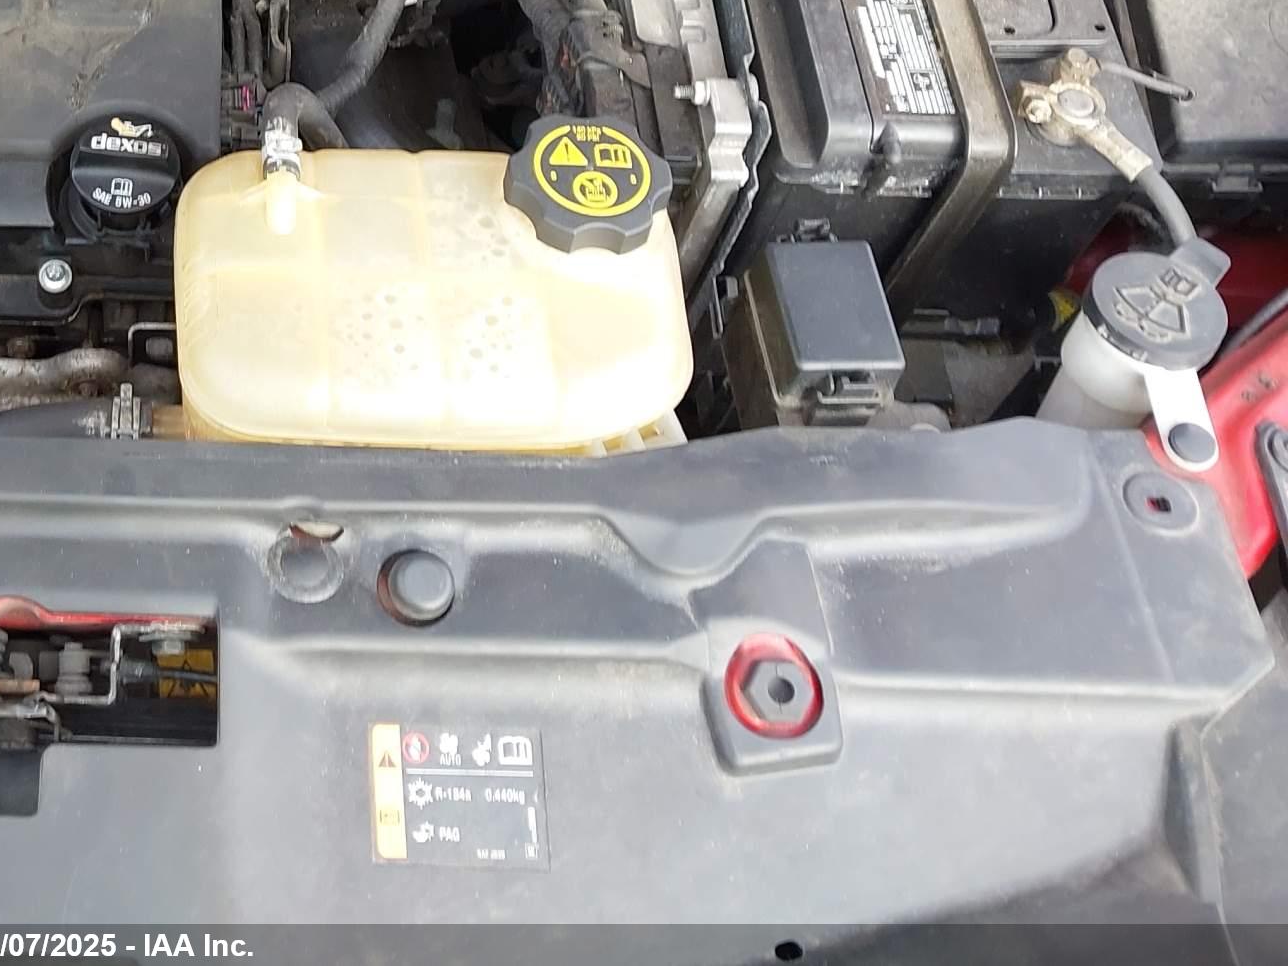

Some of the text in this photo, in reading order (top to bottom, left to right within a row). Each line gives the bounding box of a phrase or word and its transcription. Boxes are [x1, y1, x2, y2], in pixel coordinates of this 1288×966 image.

[90, 132, 162, 157] dexos
[92, 187, 112, 206] SAE
[439, 754, 461, 767] AUTO
